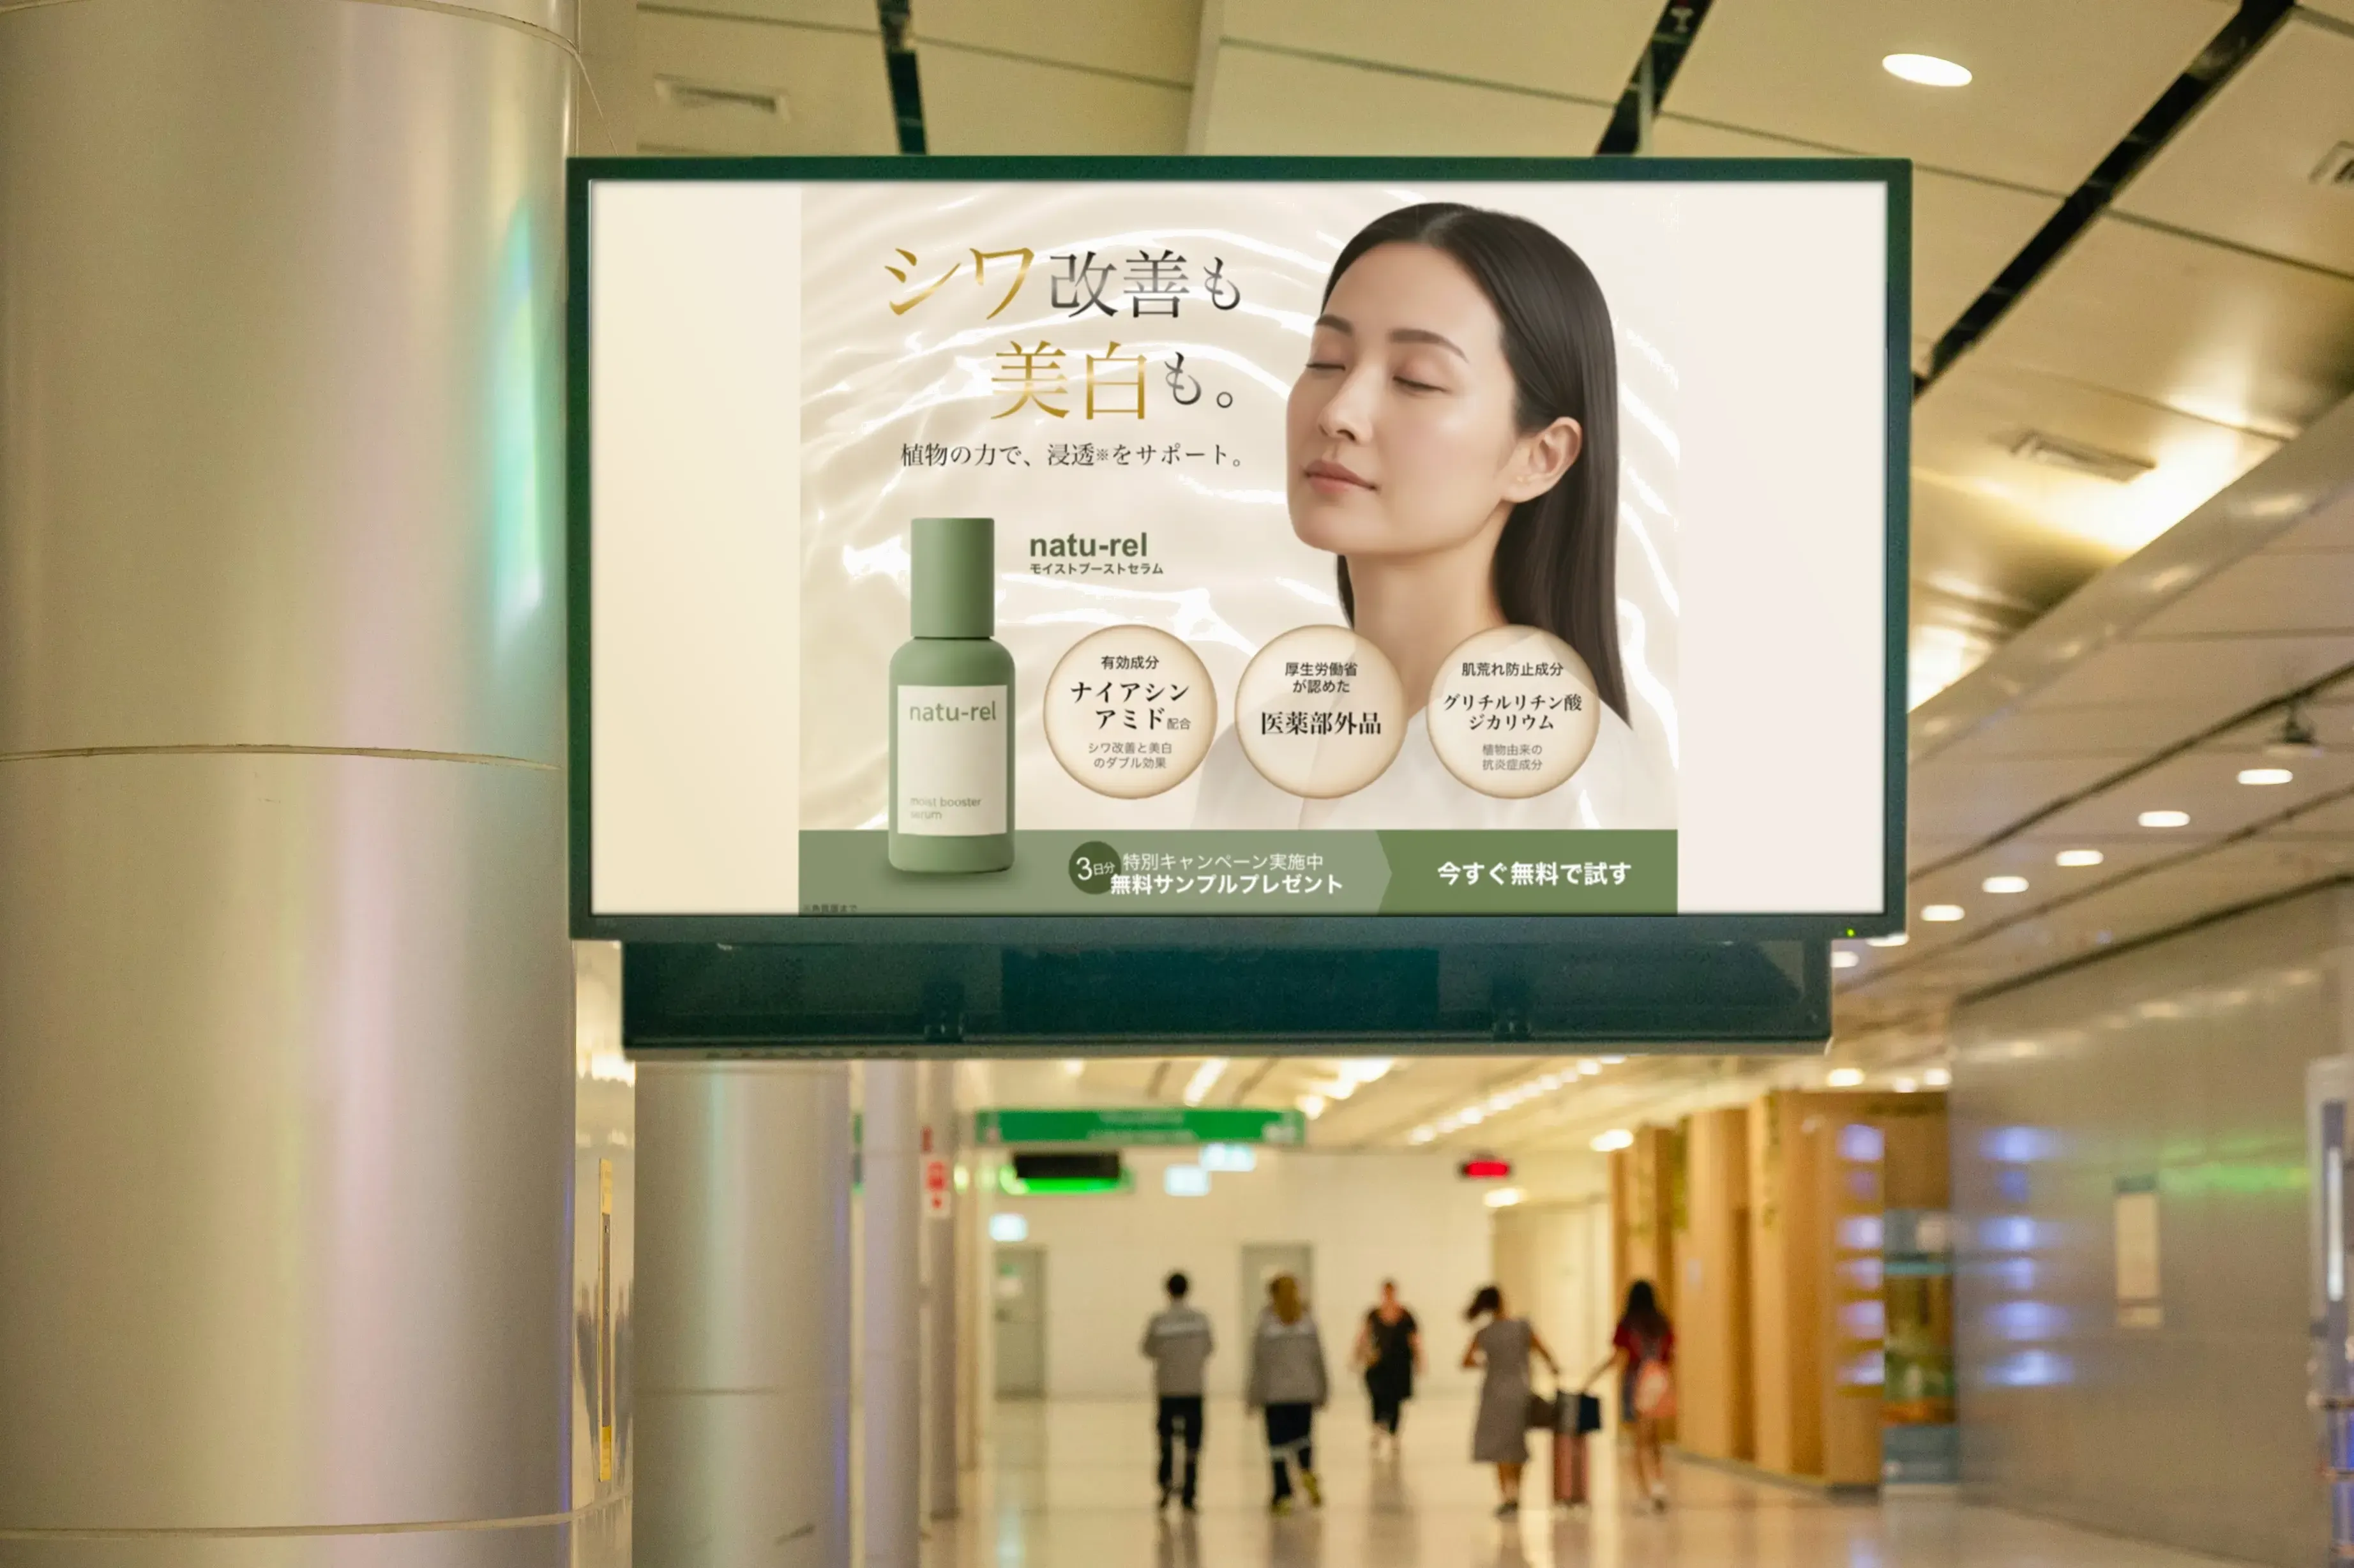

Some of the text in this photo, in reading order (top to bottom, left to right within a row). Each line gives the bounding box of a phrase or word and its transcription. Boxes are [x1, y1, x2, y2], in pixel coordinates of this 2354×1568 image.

[885, 248, 1240, 320] シワ改善も
[992, 340, 1233, 419] 美白も。
[902, 442, 1240, 467] 植物の力で、浸透※をサポート。
[1030, 532, 1147, 557] natu-rel
[1030, 562, 1163, 575] モイストブーストセラム
[1101, 656, 1159, 670] 有効成分
[1285, 662, 1357, 676] 厚生労働省
[1462, 663, 1563, 676] 肌荒れ防止成分
[1071, 682, 1188, 703] ナイアシン
[1293, 679, 1350, 693] が認めた
[910, 700, 996, 721] natu-rel
[1445, 694, 1582, 711] グリチルリチン酸
[1262, 711, 1380, 735] 医薬部外品
[1470, 714, 1553, 730] ジカリウム
[1089, 742, 1172, 753] シワ改善と美白
[1483, 744, 1542, 756] 植物由来の
[1094, 757, 1166, 769] のダブル効果
[1483, 759, 1542, 770] 抗炎症成分
[910, 797, 981, 807] moist booster
[911, 810, 942, 820] serum
[1123, 853, 1323, 871] 特別キャンペーン実施中
[1438, 861, 1631, 886] 今すぐ無料で試す
[1111, 874, 1342, 895] 無料サンプルプレゼント
